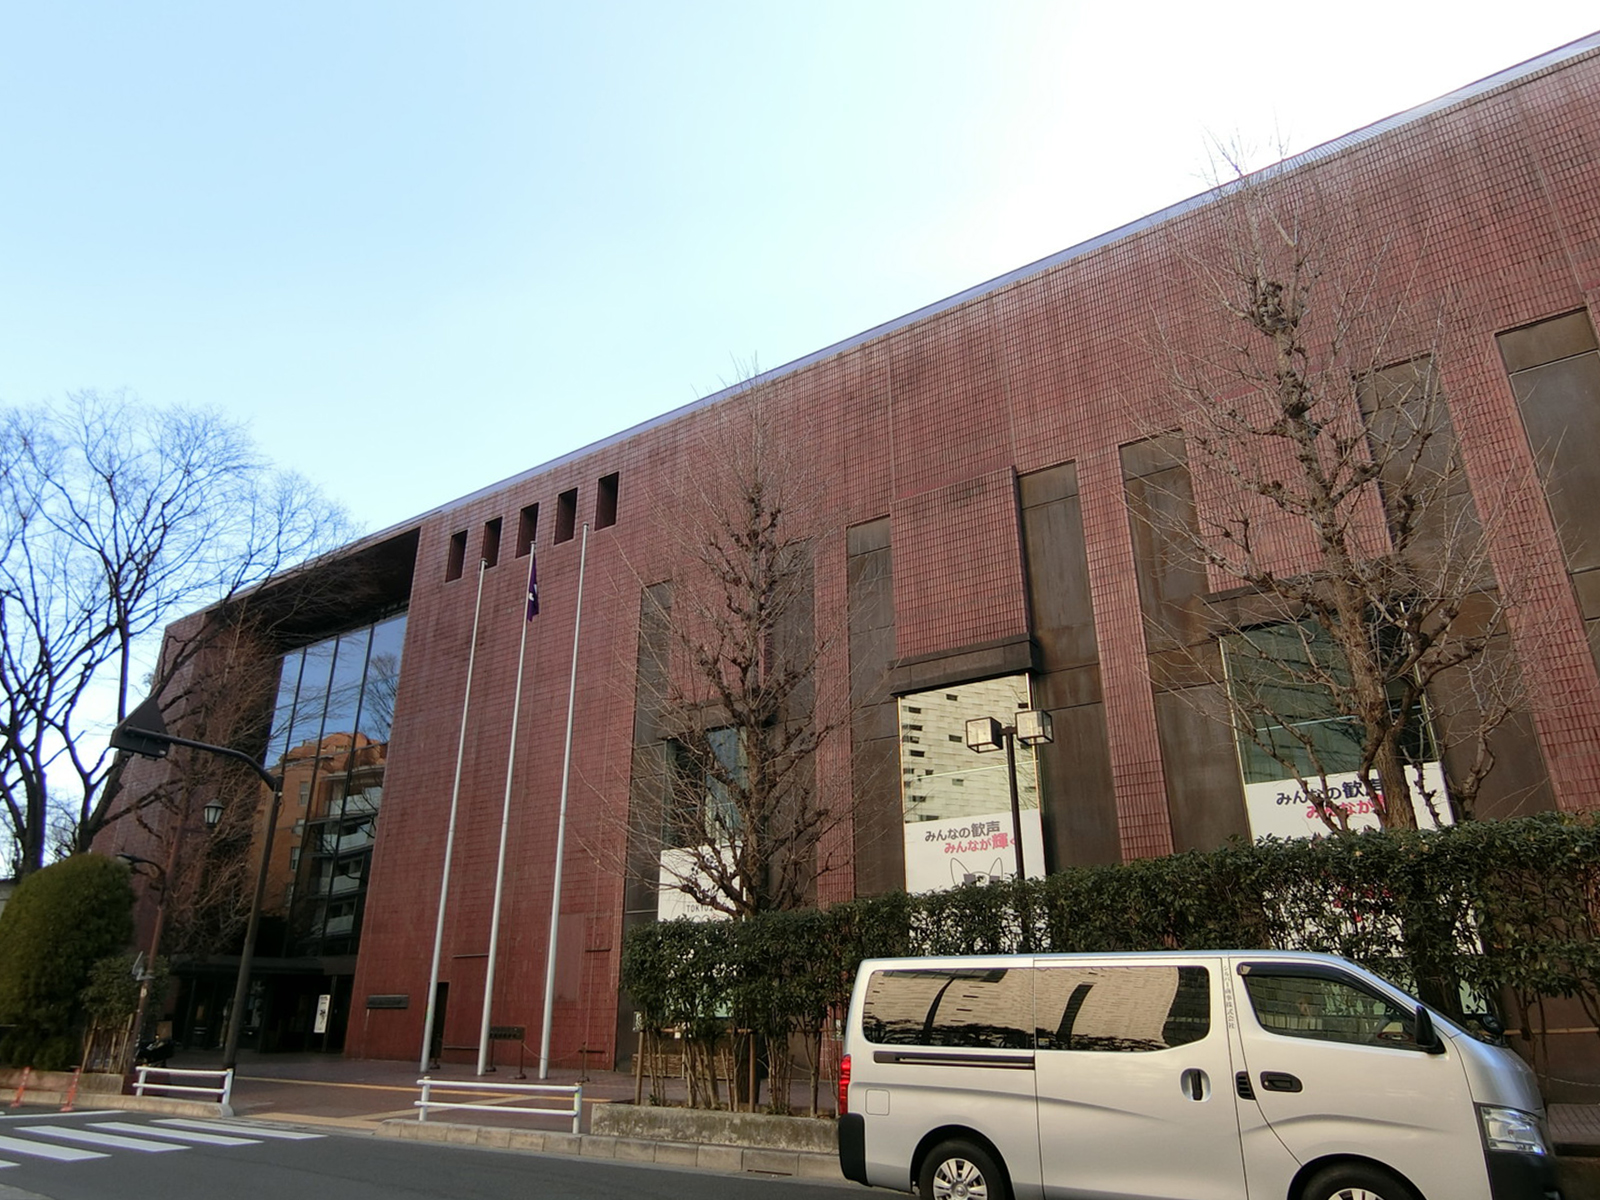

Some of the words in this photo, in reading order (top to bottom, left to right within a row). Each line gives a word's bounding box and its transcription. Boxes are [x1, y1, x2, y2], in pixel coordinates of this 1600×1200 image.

[925, 821, 1000, 842] みんなの歓声
